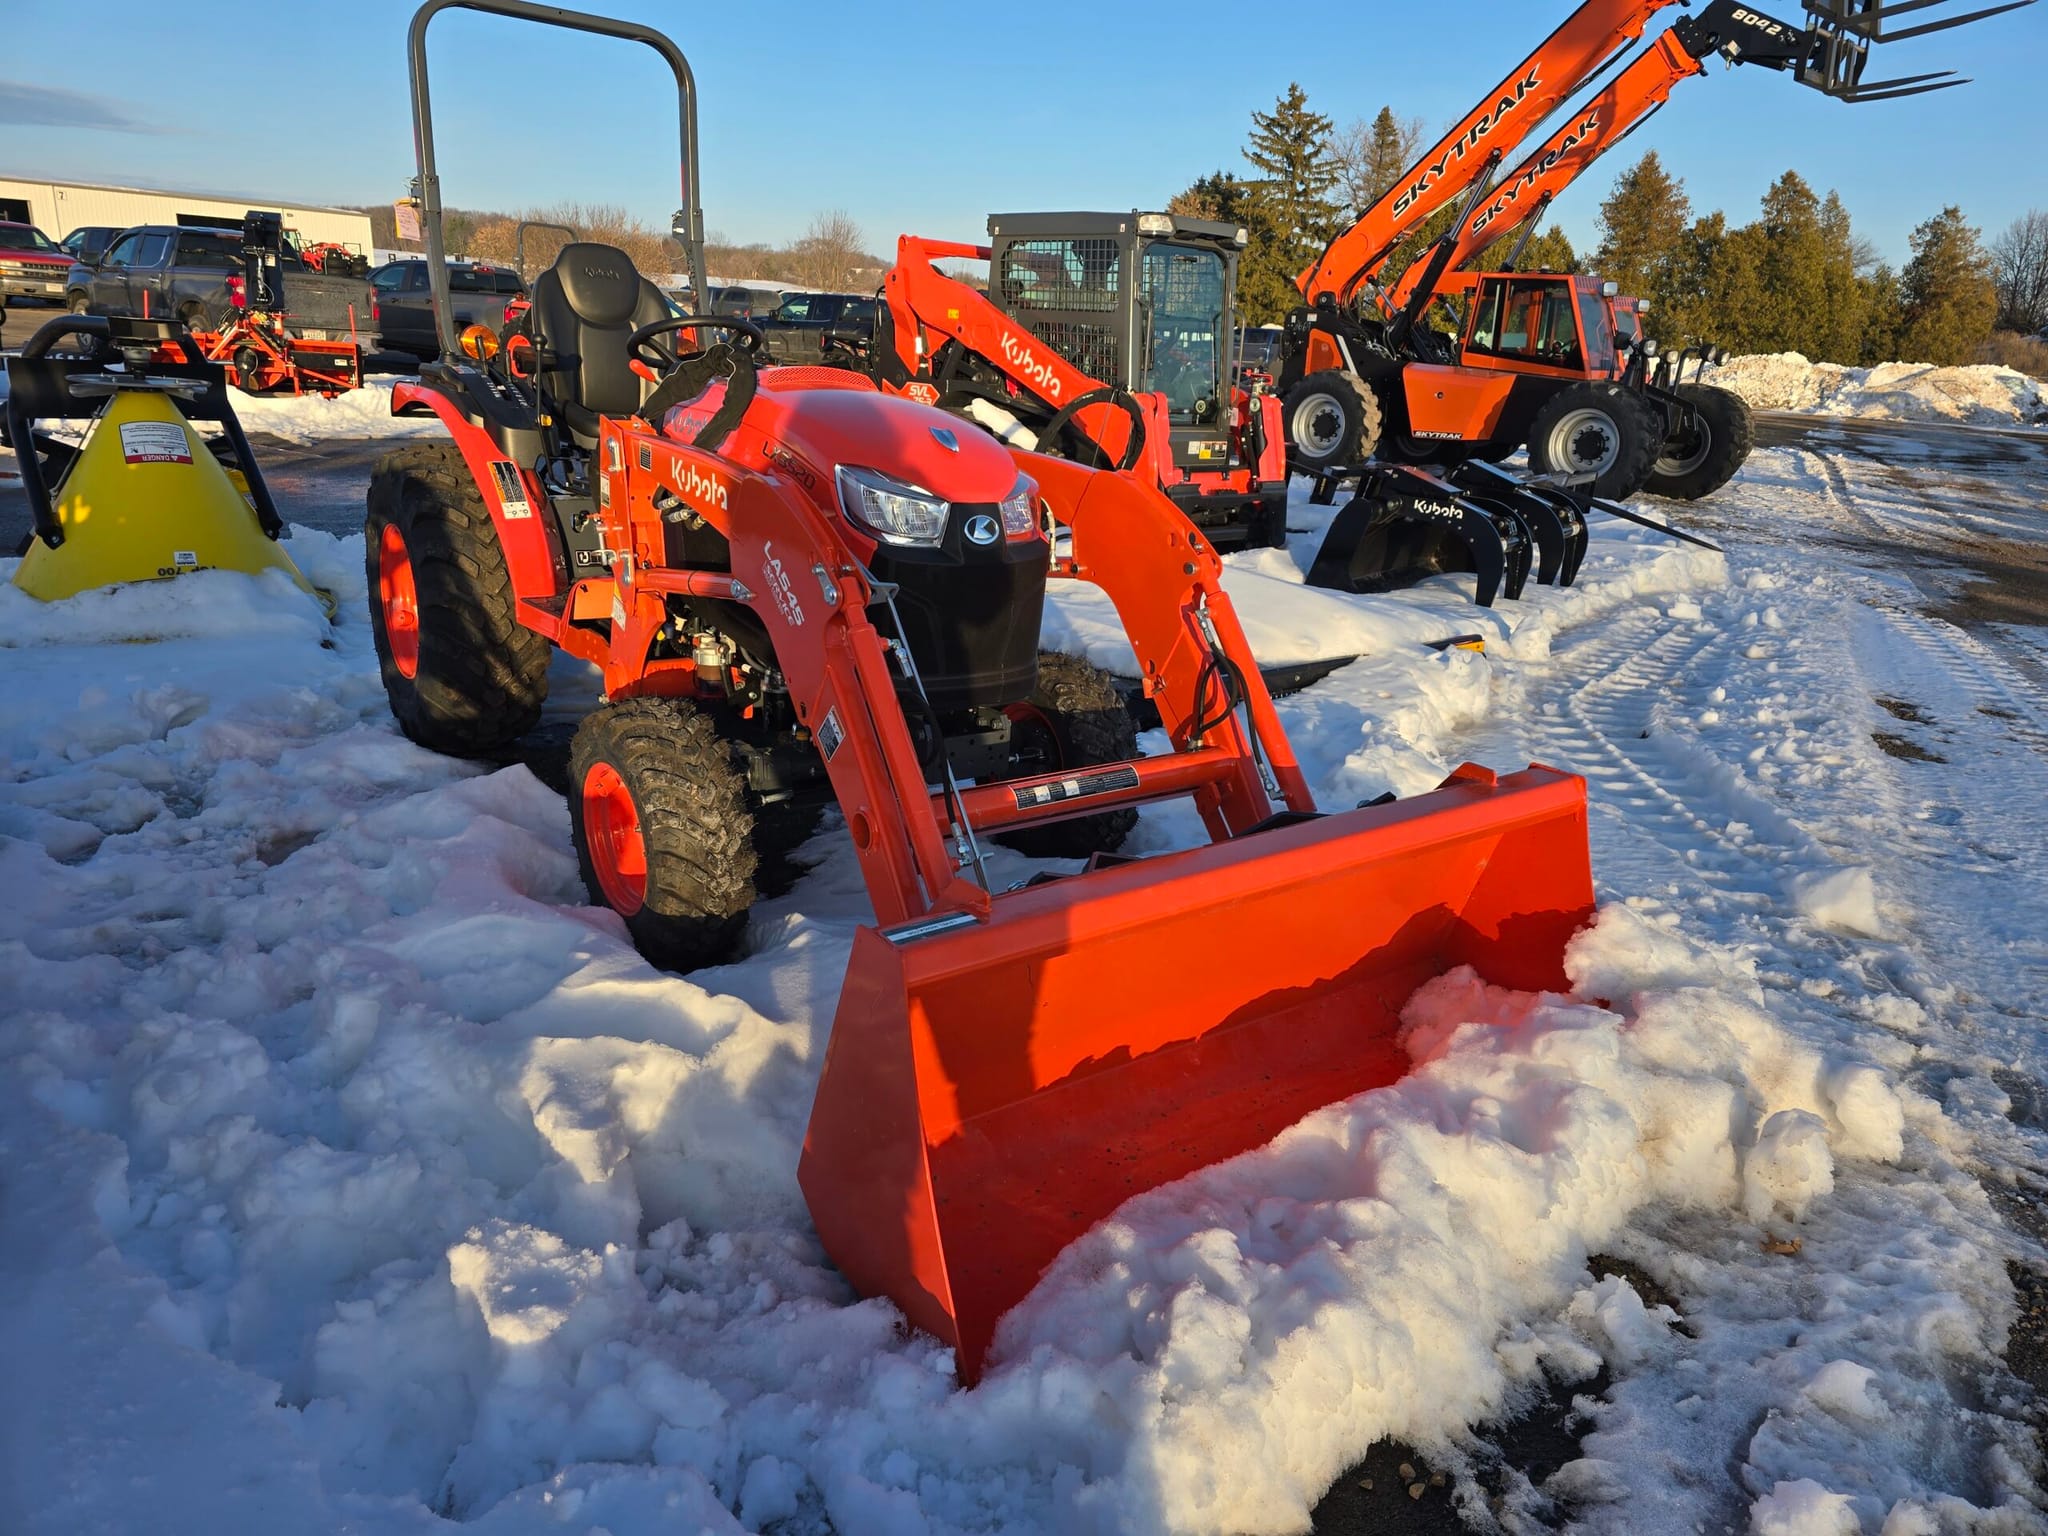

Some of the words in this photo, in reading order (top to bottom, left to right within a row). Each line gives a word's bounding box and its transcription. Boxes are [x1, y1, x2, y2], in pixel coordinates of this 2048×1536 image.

[1731, 8, 1783, 36] 8042
[1392, 61, 1543, 221] SKYTRAK
[1472, 107, 1600, 236] SKYTRAK
[1001, 331, 1061, 397] Kubota
[909, 384, 932, 398] SVL
[1414, 431, 1462, 439] SKYTRAK
[142, 454, 170, 462] DANGER
[671, 456, 728, 510] Kubota
[1414, 499, 1463, 519] Kubota
[764, 540, 805, 626] LA545
